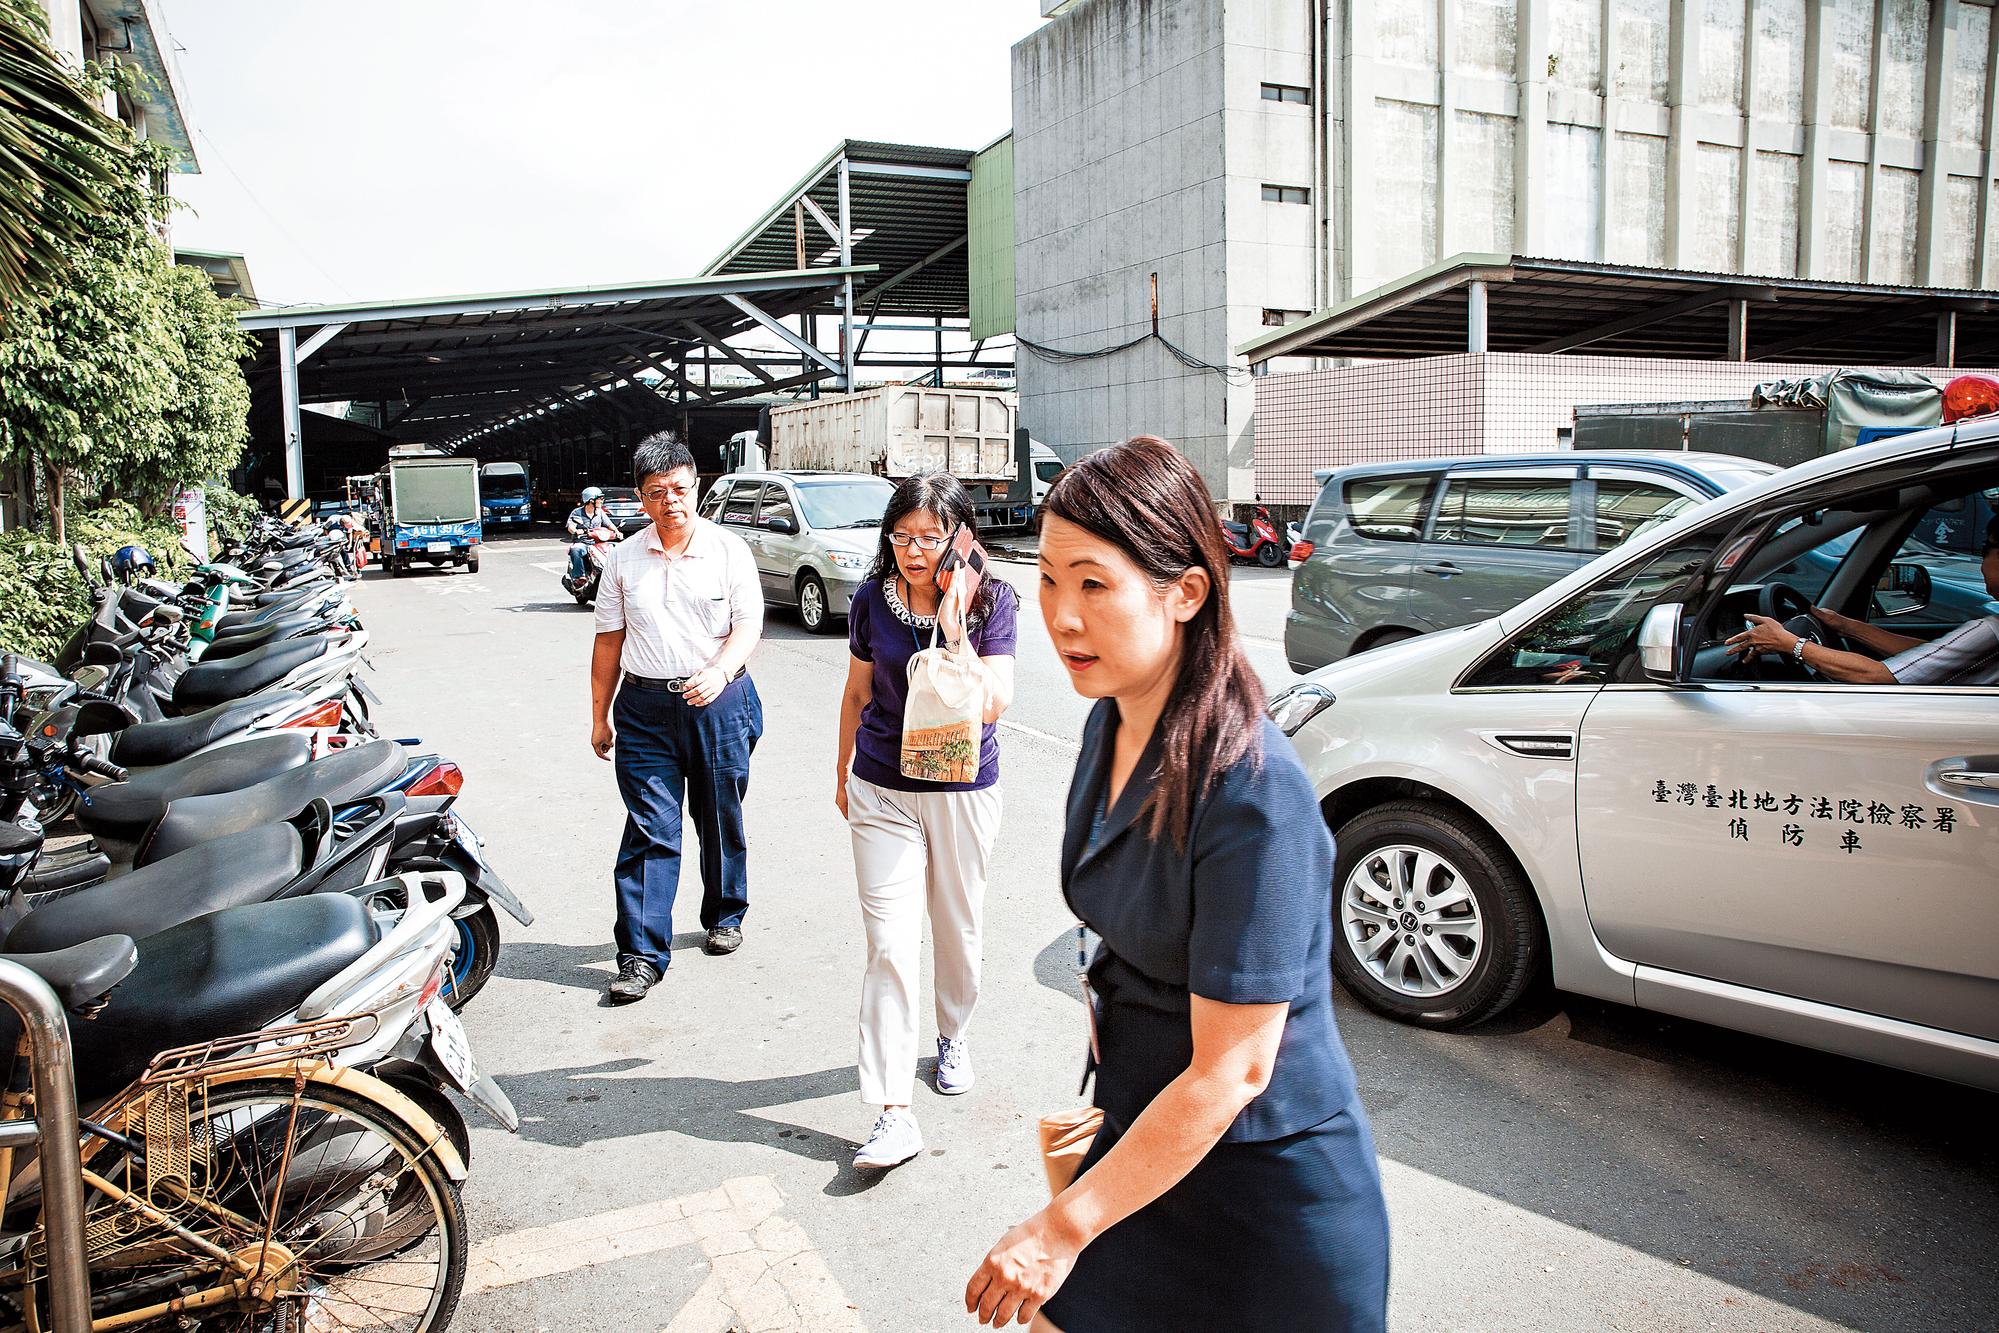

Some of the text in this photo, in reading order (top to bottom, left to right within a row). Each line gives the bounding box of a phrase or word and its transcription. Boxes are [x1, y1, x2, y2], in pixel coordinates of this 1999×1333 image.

[1651, 779, 1958, 834] 臺灣臺北地方法院檢察署
[1728, 817, 1863, 854] 偵防車
